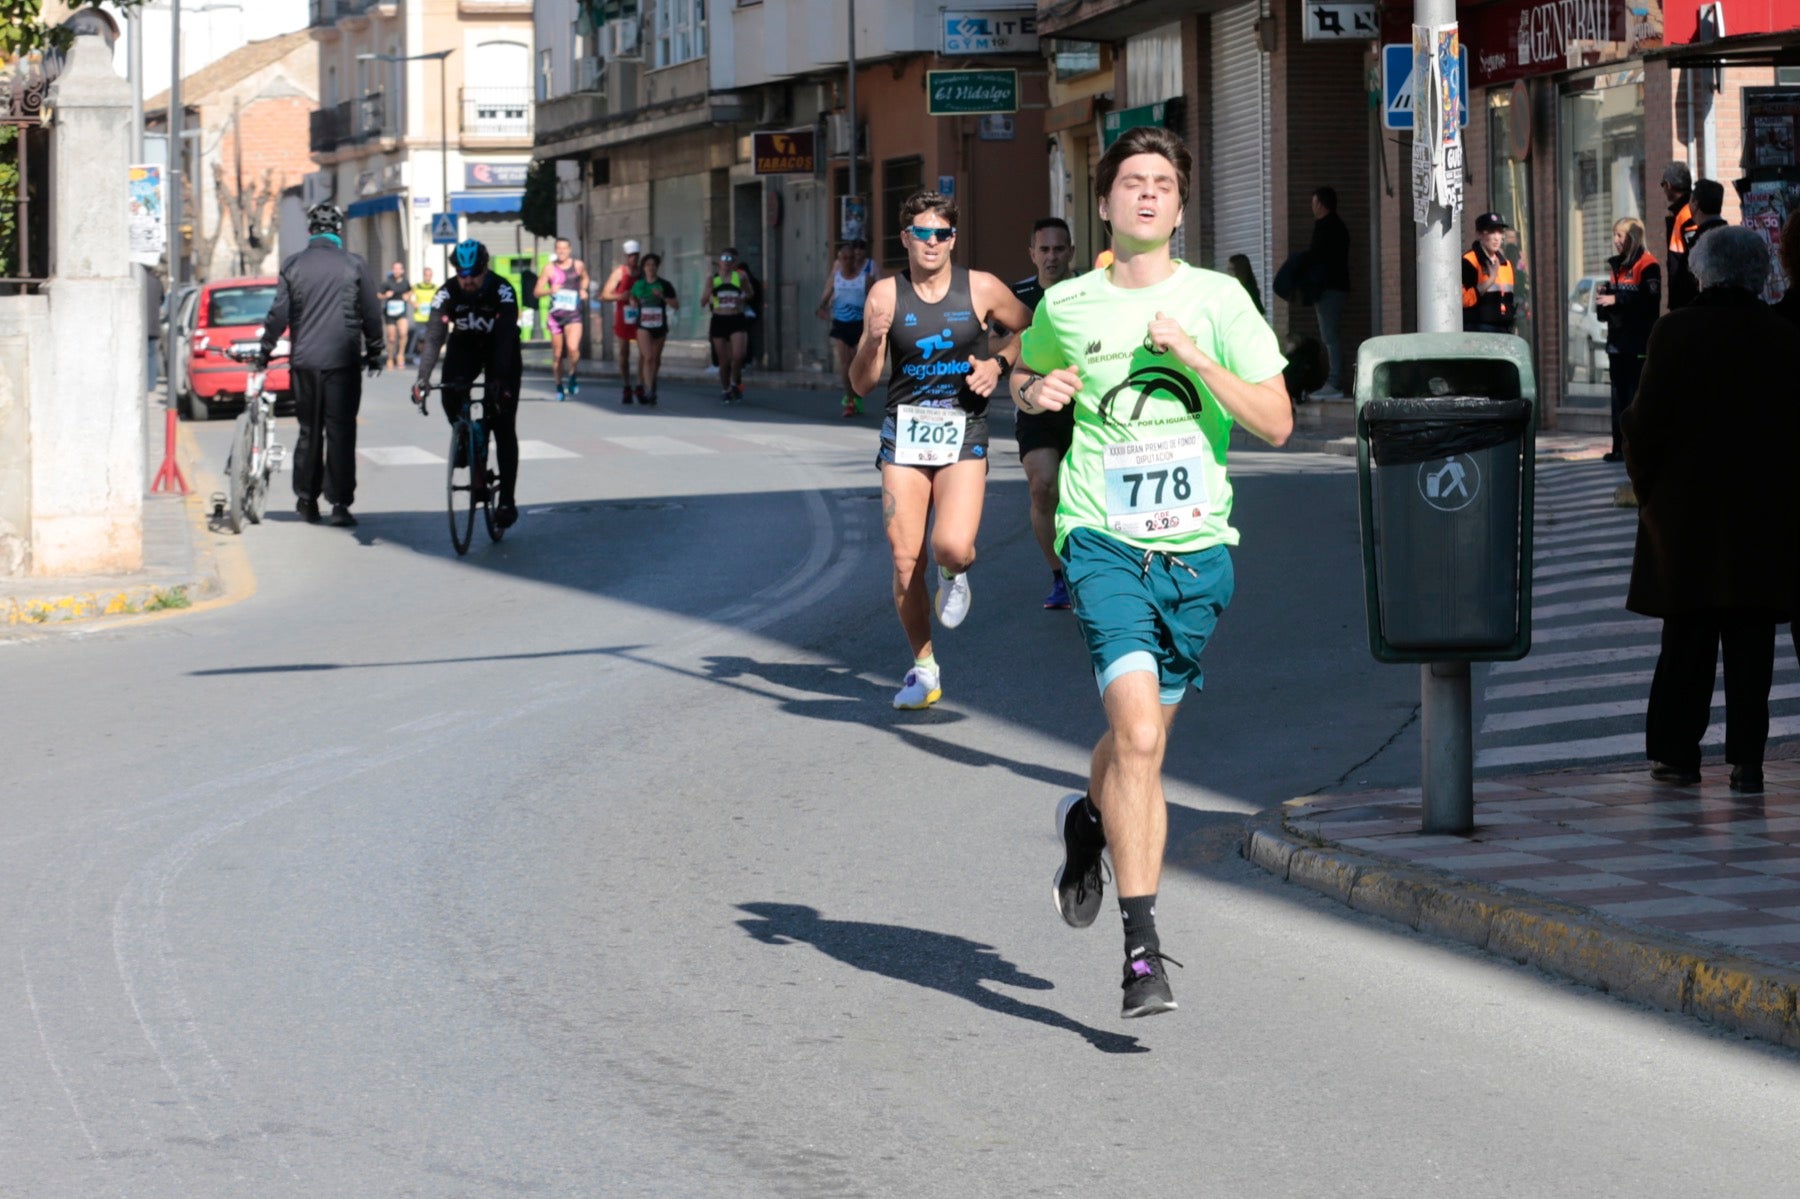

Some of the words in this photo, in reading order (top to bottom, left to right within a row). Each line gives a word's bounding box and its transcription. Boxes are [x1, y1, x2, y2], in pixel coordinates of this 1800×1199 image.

[955, 16, 1037, 37] ELITE
[1530, 0, 1610, 62] GENERALI
[947, 39, 989, 50] GYM
[955, 85, 1012, 102] Hidalgo
[757, 156, 814, 173] TABACOS
[455, 312, 495, 332] sky
[1087, 351, 1135, 365] IBERDROLA
[902, 359, 971, 380] vegabike
[907, 418, 959, 445] 1202
[1137, 419, 1153, 427] POR
[1154, 418, 1165, 426] LA
[1126, 443, 1144, 455] GRAN
[1144, 441, 1169, 453] PREMIO
[1169, 439, 1177, 448] DE
[1177, 435, 1197, 447] FONDO
[1122, 466, 1192, 508] 778
